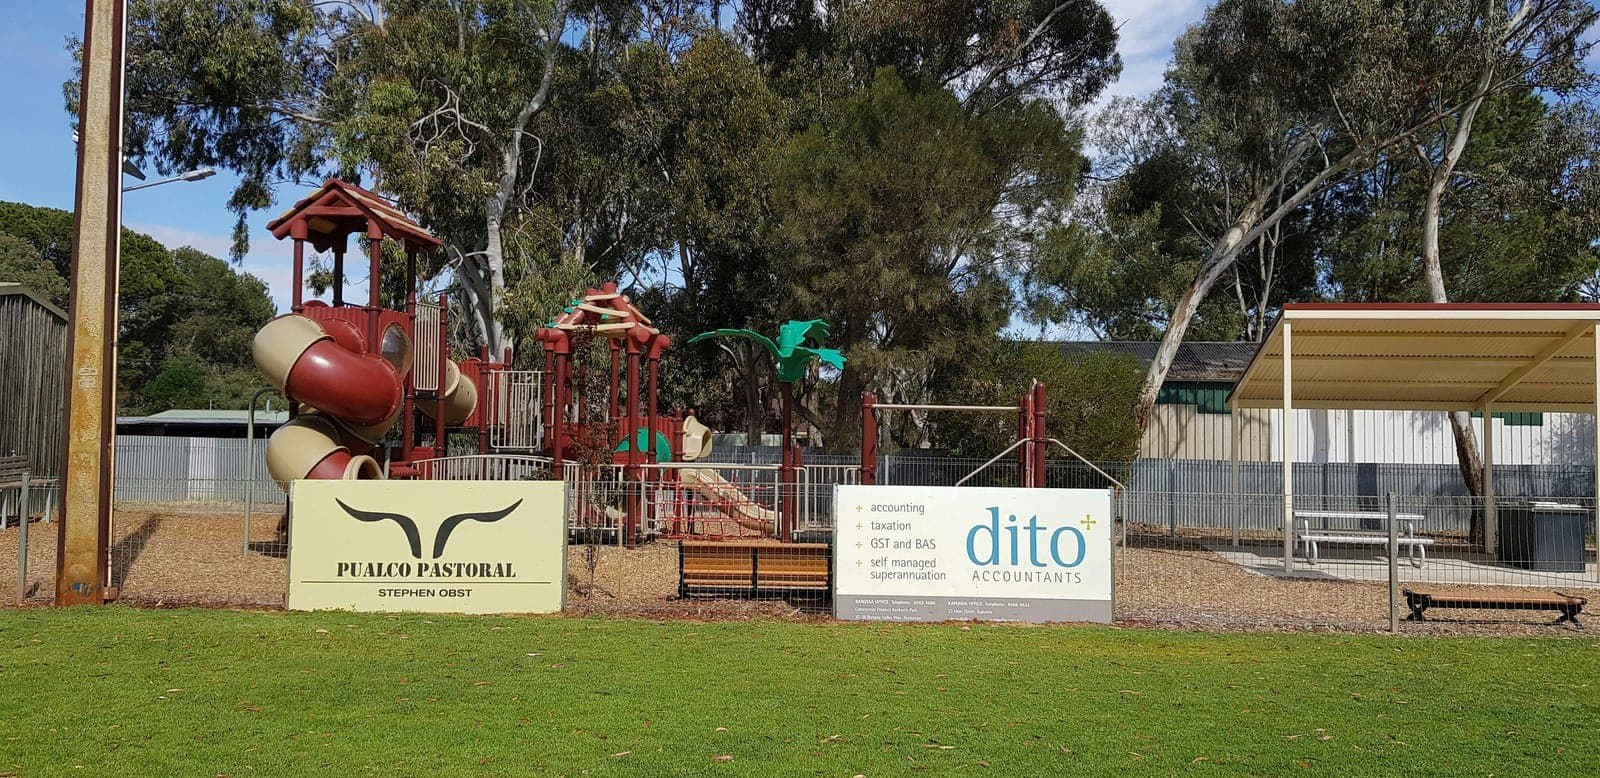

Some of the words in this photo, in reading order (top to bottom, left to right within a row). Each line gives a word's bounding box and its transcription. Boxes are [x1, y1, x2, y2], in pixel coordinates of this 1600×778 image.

[870, 502, 925, 515] accounting
[870, 520, 911, 531] taxation
[870, 538, 890, 549] GST
[893, 539, 911, 549] and
[915, 539, 936, 550] BAS
[966, 507, 1086, 568] dito
[337, 562, 411, 578] PUALCO
[417, 562, 516, 578] PASTORAL
[870, 557, 888, 568] self
[891, 558, 936, 570] managed
[870, 570, 946, 582] superannuation
[972, 570, 1082, 584] ACCOUNTANTS
[378, 588, 435, 597] STEPHEN
[439, 588, 472, 597] OBST
